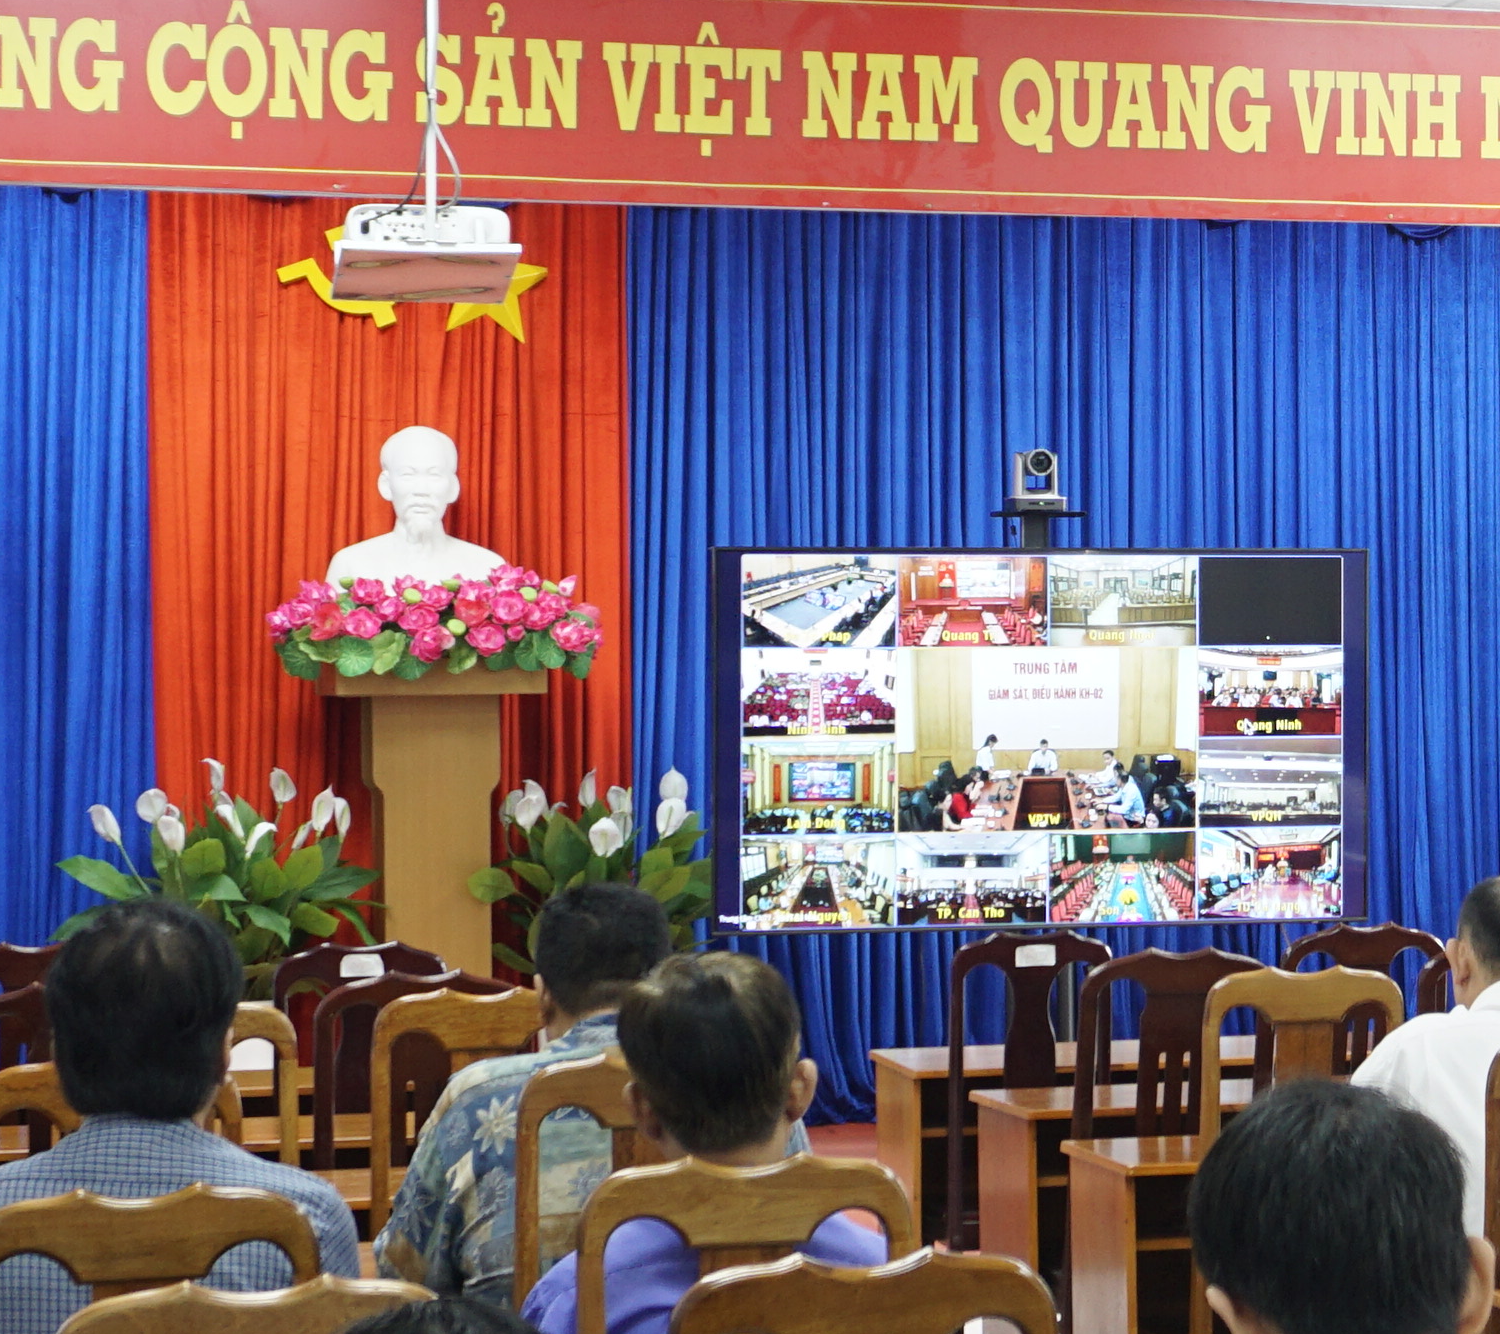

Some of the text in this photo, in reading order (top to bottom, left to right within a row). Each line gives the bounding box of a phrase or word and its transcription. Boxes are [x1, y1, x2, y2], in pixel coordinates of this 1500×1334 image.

[146, 0, 395, 141] CỘNG
[414, 2, 584, 130] SẢN
[602, 21, 782, 157] VIỆT
[802, 50, 980, 144] NAM
[999, 57, 1272, 154] QUANG
[1288, 69, 1462, 159] VINH
[942, 630, 979, 644] Quang
[1088, 629, 1125, 643] Quang
[1013, 662, 1050, 675] TRUNG
[1276, 719, 1302, 731] Ninh
[936, 907, 1005, 920] TP. Can Tho
